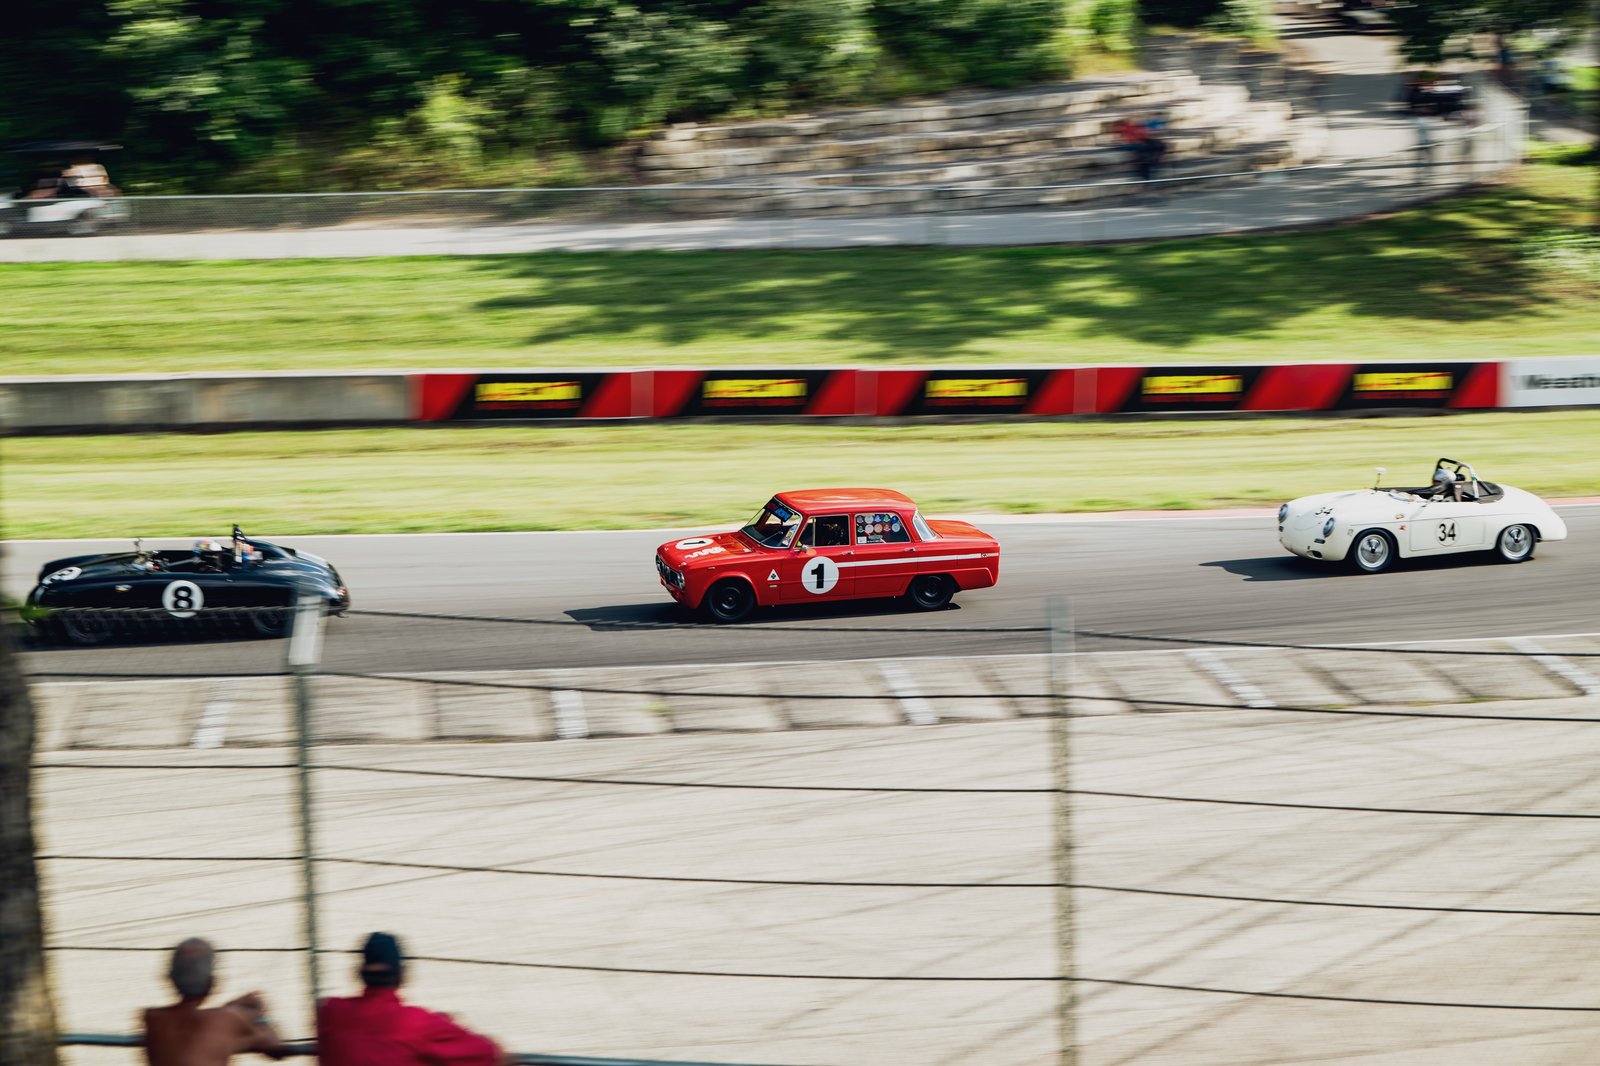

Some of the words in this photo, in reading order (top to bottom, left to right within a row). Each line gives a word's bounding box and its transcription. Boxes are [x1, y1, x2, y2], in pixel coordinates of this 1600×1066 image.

[1314, 506, 1334, 516] 34
[1438, 522, 1456, 542] 34
[811, 563, 825, 589] 1
[173, 586, 193, 611] 8
